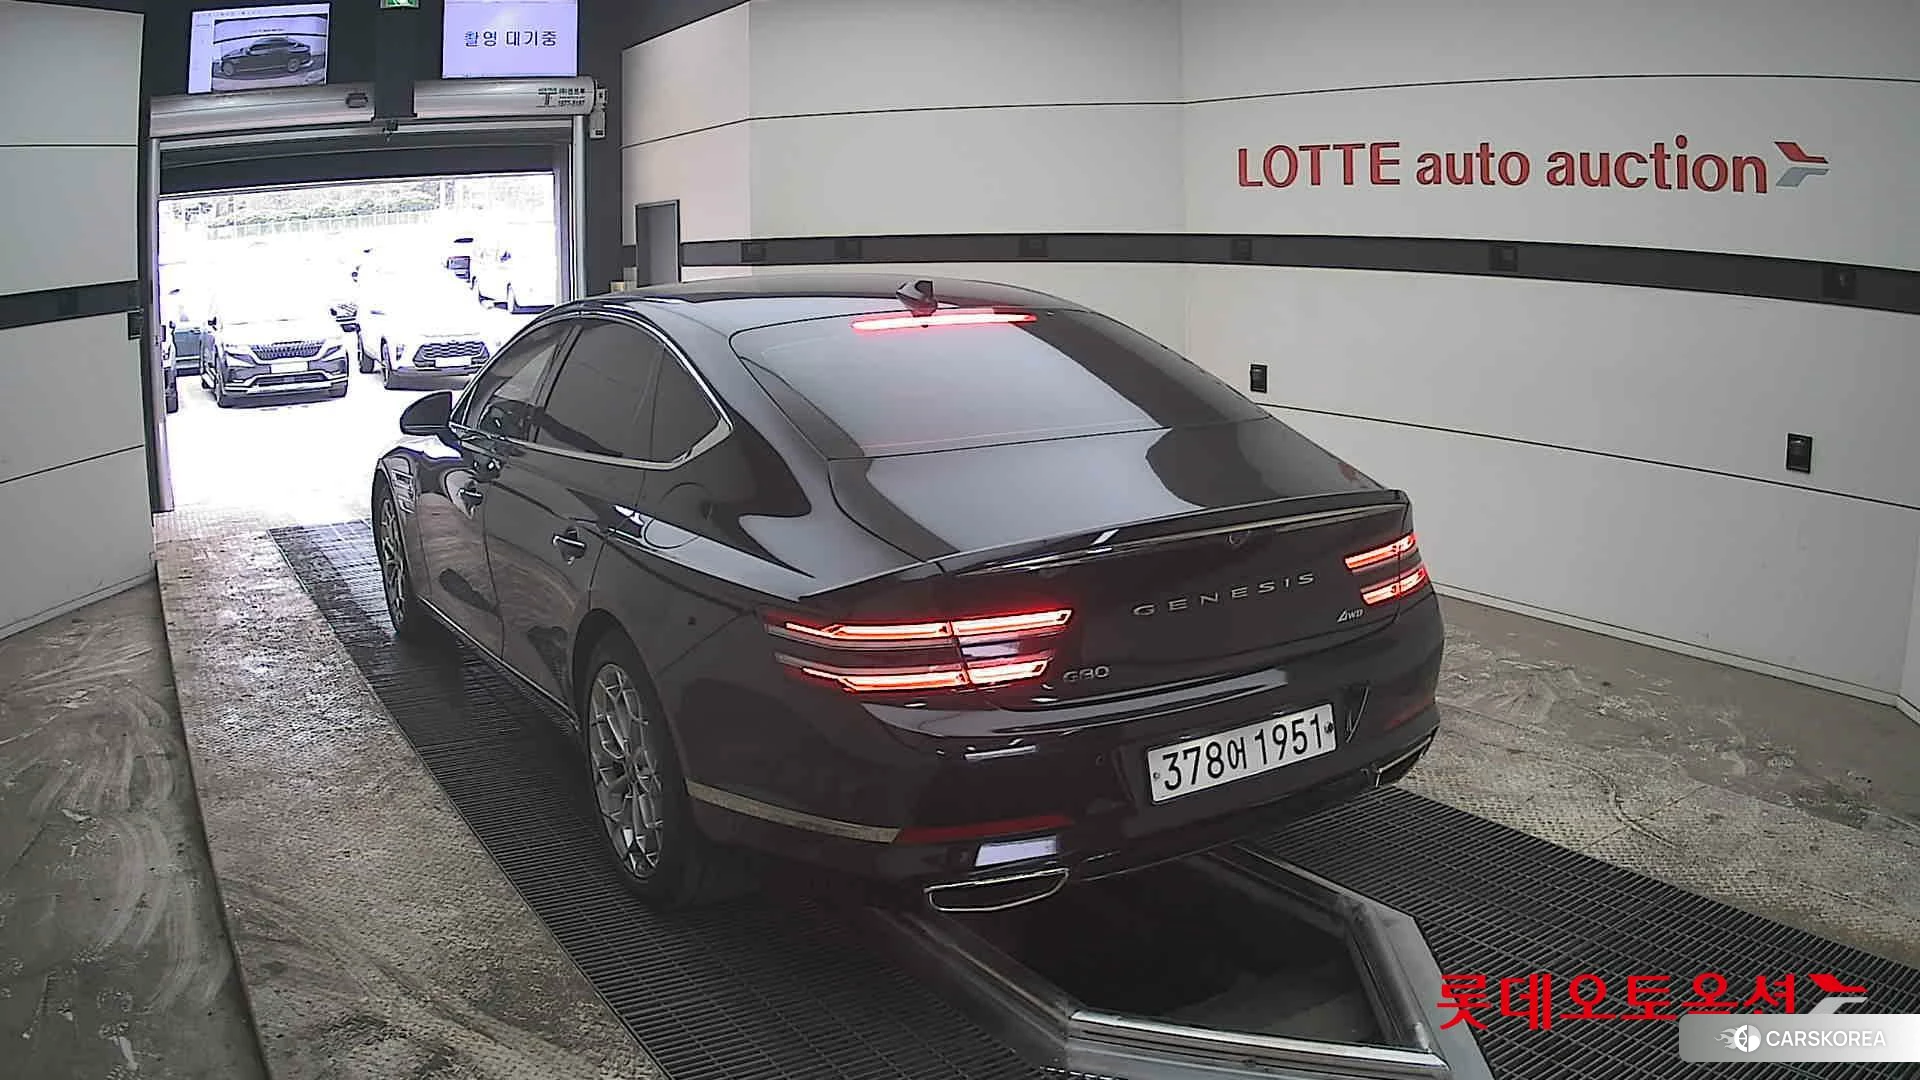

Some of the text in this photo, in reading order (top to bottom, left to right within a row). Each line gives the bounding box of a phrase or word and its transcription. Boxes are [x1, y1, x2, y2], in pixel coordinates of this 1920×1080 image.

[506, 31, 557, 47] 대기중
[1238, 135, 1767, 194] LOTTE auto auction
[1133, 573, 1314, 616] GENESIS
[1063, 665, 1110, 683] G80
[1162, 713, 1322, 790] 378어 1951
